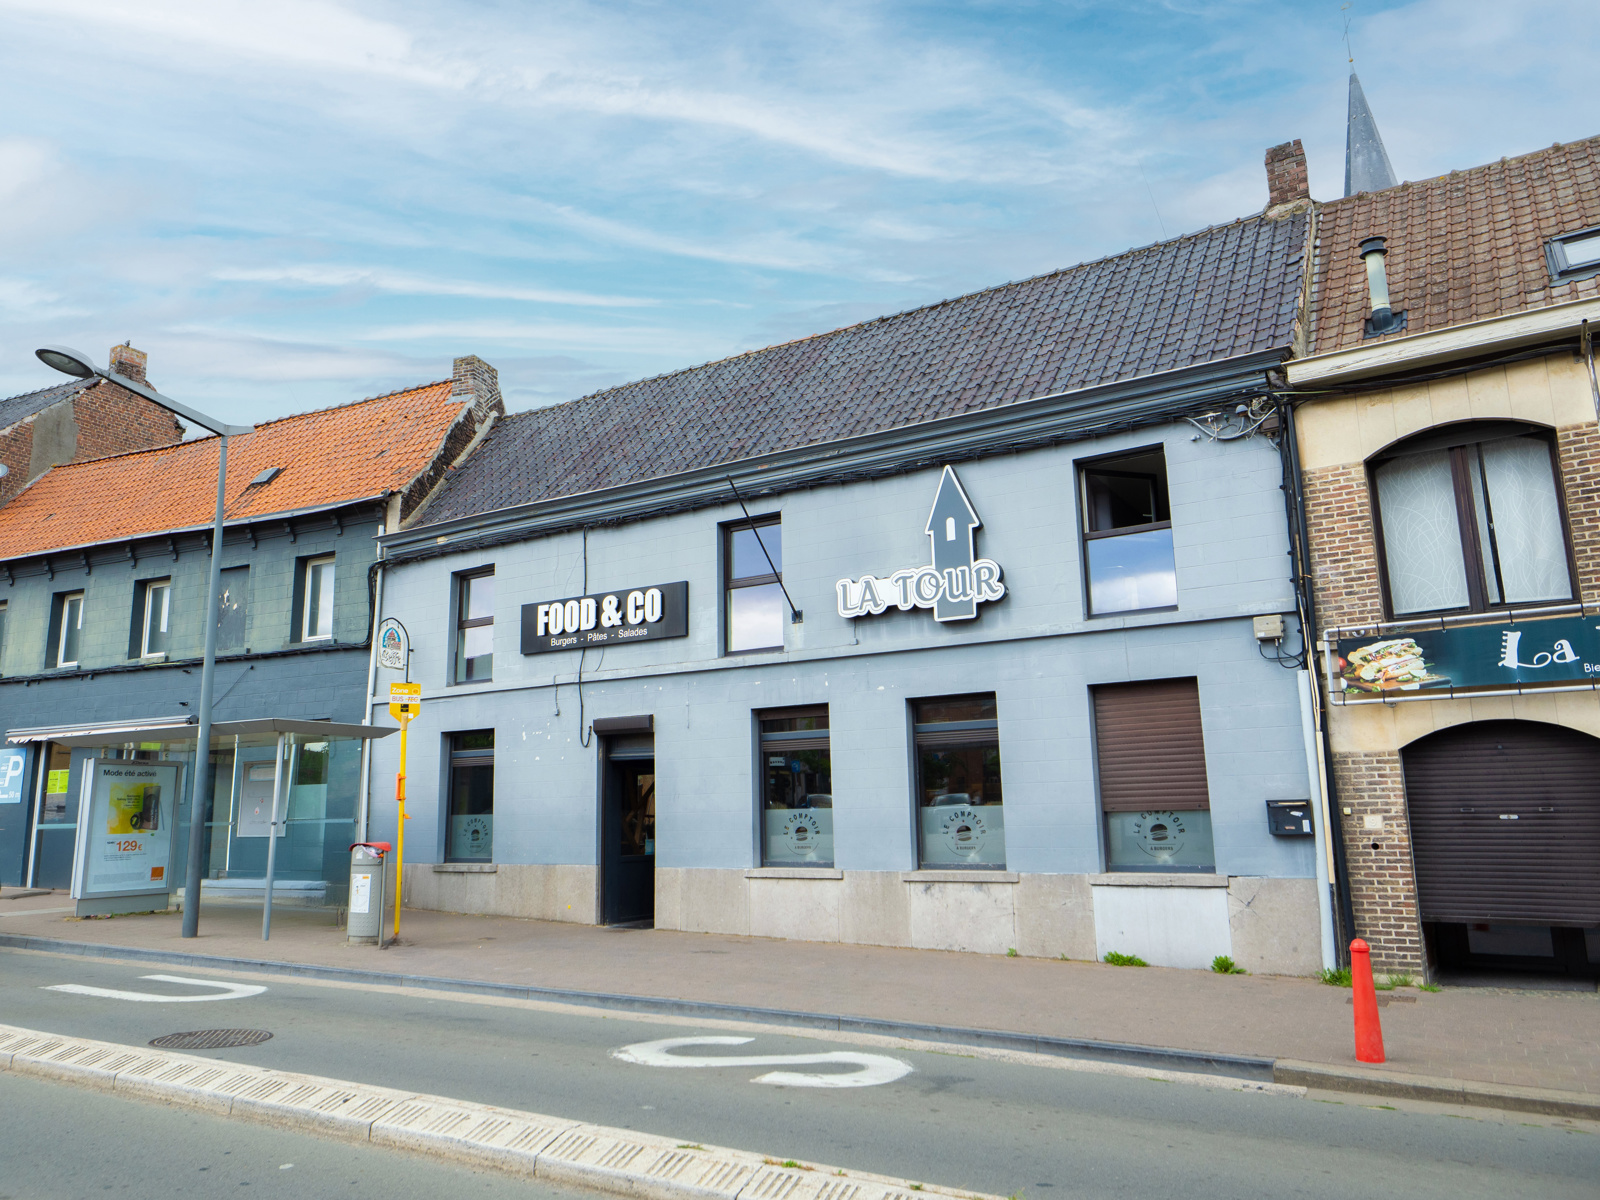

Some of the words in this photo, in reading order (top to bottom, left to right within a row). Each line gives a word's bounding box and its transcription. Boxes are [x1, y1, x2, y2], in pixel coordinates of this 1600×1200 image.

[838, 578, 885, 614] LA
[892, 564, 1001, 606] TOUR
[537, 598, 598, 636] FOOD
[601, 595, 623, 627] &
[627, 588, 663, 625] CO
[550, 635, 578, 647] Burgers
[587, 631, 608, 642] Pâtes
[618, 627, 648, 639] Salades
[1497, 630, 1581, 670] La
[103, 769, 123, 777] Mode
[124, 769, 136, 777] été
[136, 769, 157, 777] activé
[789, 812, 821, 835] COMPTOIR
[942, 824, 950, 835] LE
[949, 810, 987, 835] COMPTOIR
[1133, 822, 1142, 834] LE
[1370, 818, 1377, 827] 9
